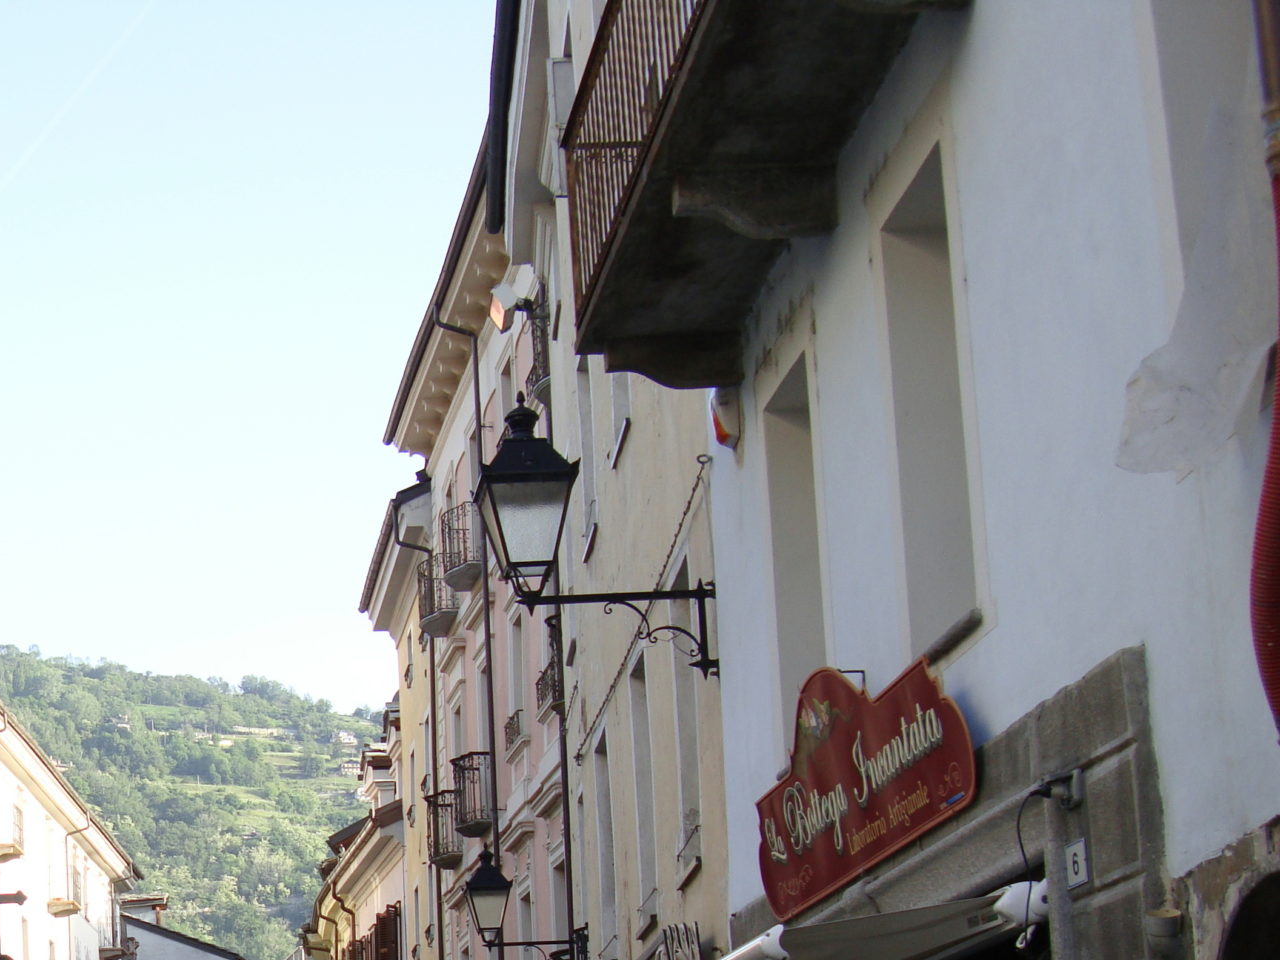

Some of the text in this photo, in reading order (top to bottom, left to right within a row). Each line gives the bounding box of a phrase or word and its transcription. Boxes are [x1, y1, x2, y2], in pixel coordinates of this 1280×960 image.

[765, 702, 942, 860] La Bottega Incantata
[846, 813, 887, 855] Laboratorio
[888, 780, 930, 826] Artigianale
[1072, 852, 1080, 876] 6
